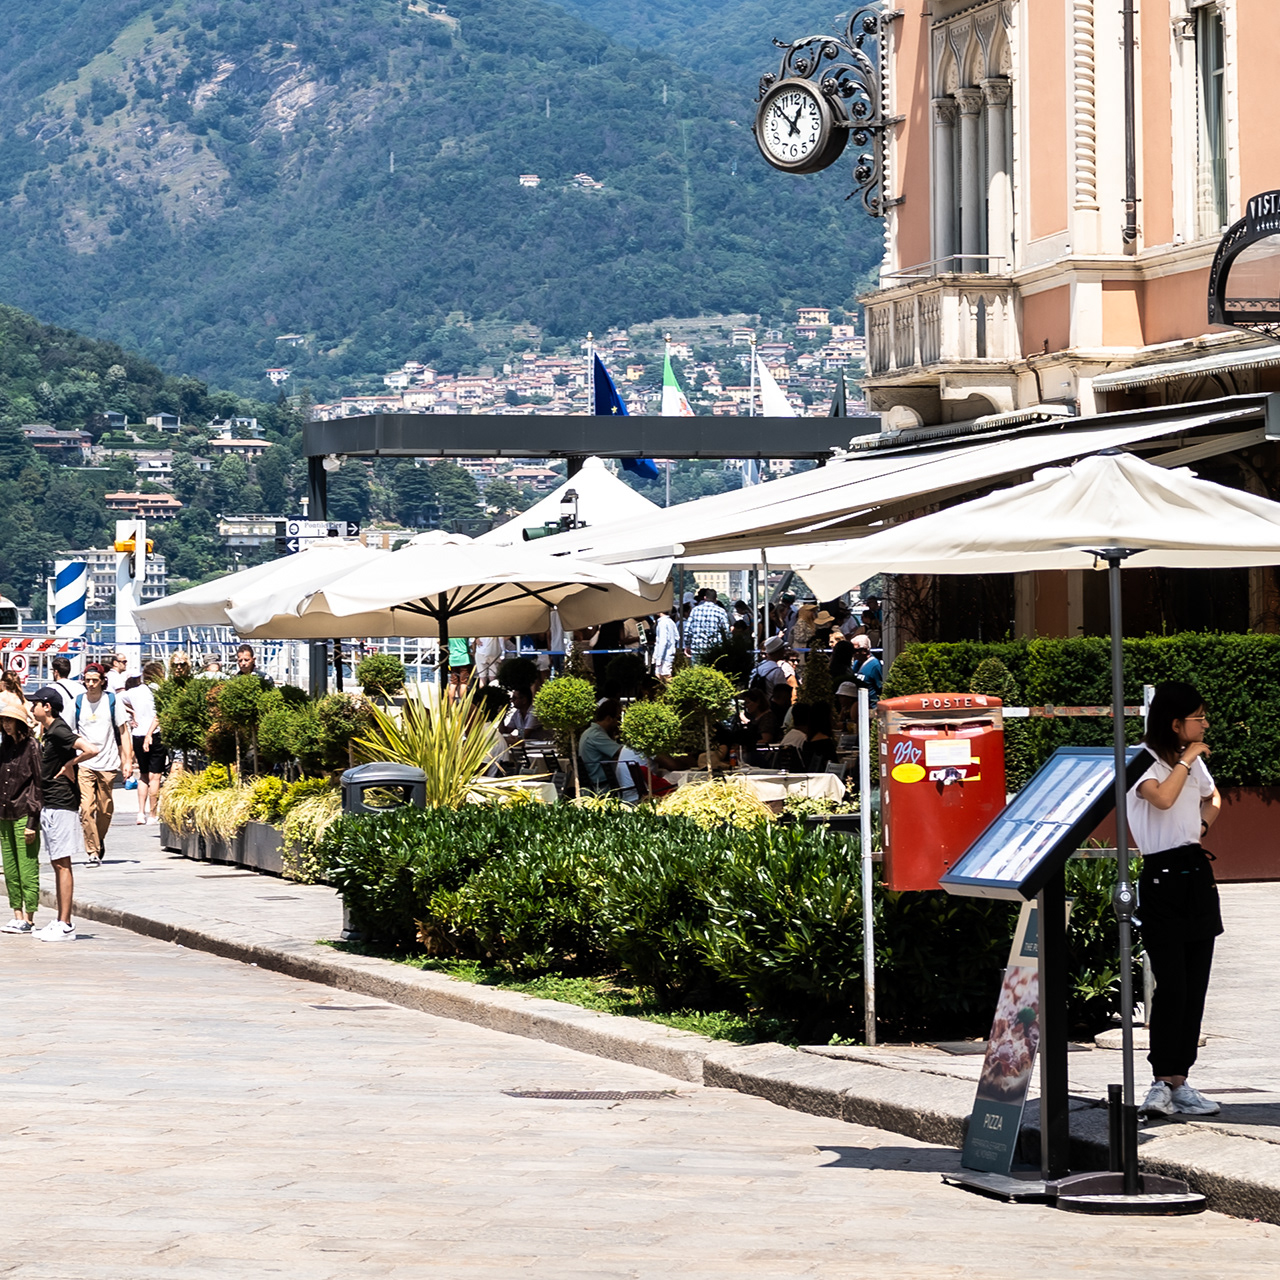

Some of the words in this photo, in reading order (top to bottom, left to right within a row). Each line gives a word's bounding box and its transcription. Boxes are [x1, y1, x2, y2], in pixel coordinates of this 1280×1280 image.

[781, 95, 789, 110] 11
[790, 93, 801, 106] 12
[803, 96, 807, 109] 1
[809, 103, 817, 115] 2
[771, 119, 778, 131] 9
[812, 117, 820, 130] 3
[773, 132, 780, 145] 8
[809, 133, 816, 144] 4
[782, 143, 788, 154] 7
[790, 143, 798, 157] 6
[801, 142, 808, 154] 5
[920, 697, 973, 709] POSTE
[983, 1113, 1004, 1131] PIZZA
